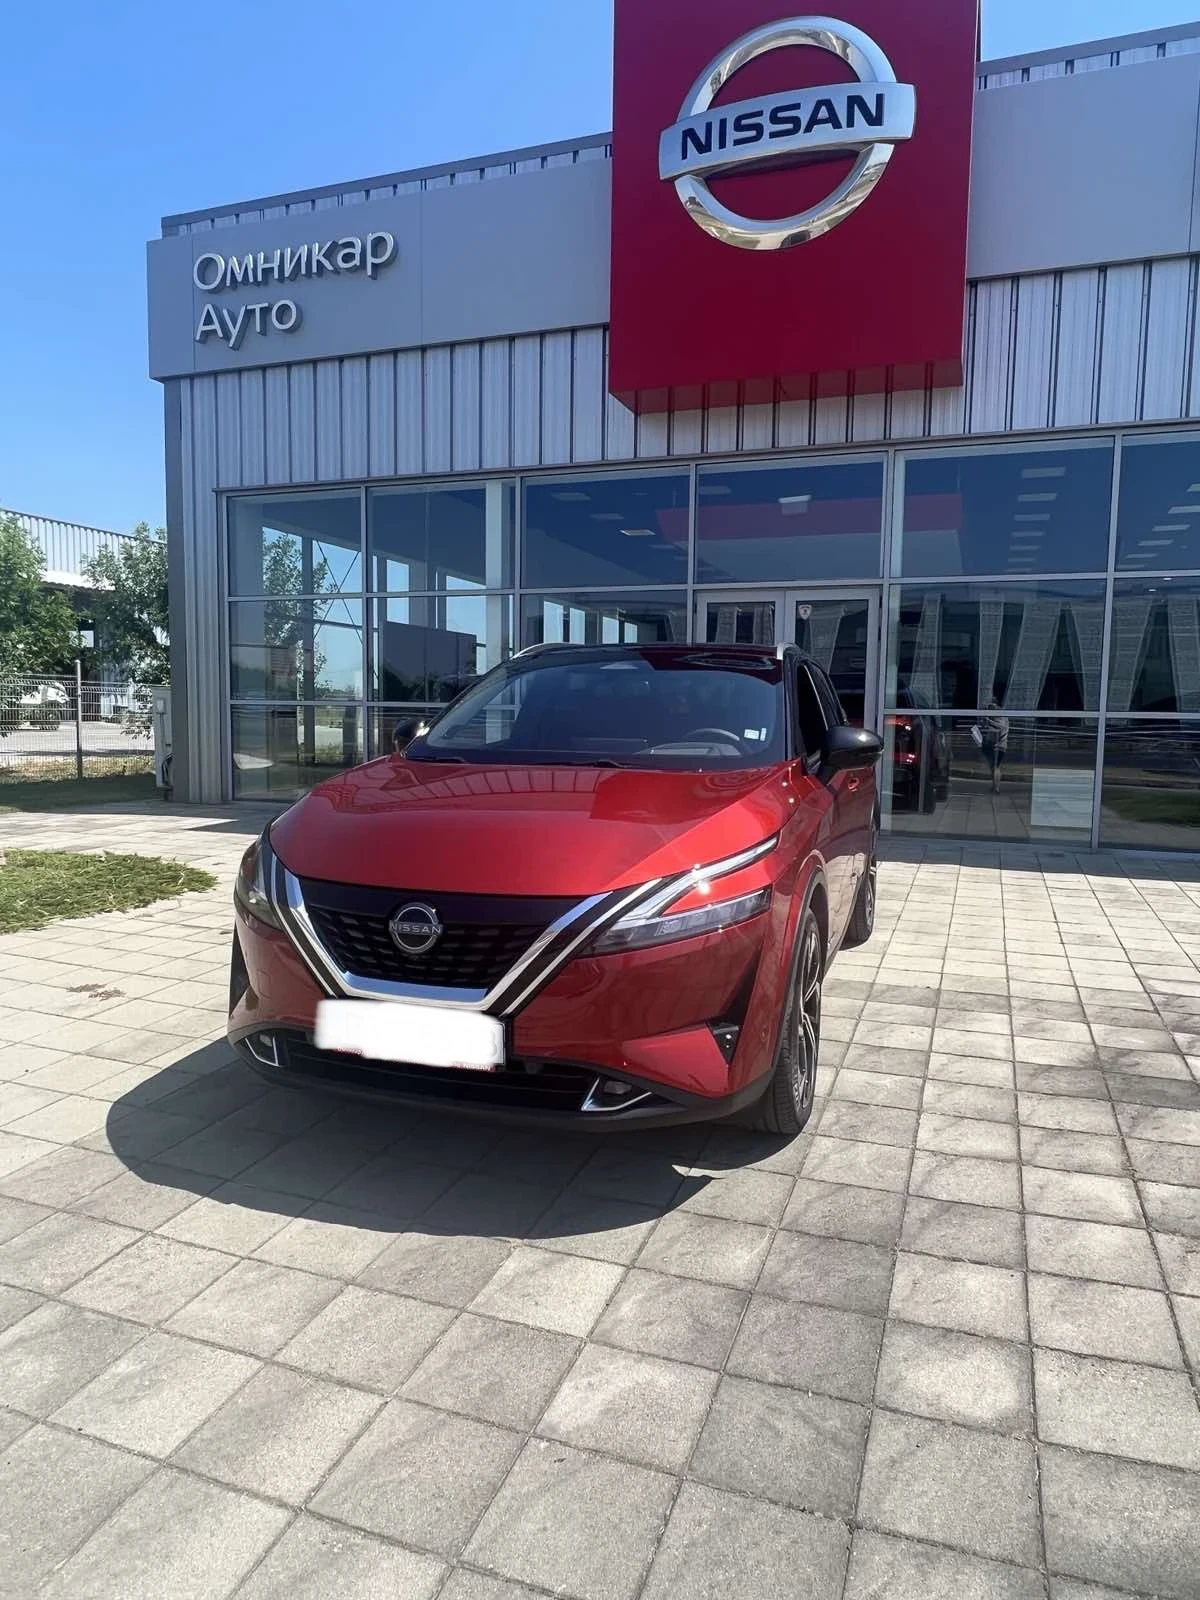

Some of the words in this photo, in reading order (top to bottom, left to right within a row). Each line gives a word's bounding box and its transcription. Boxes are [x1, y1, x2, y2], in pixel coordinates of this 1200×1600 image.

[681, 93, 884, 160] NISSAN
[193, 231, 394, 290] Омникар
[195, 300, 297, 348] Ауто
[391, 922, 441, 935] NISSAN
